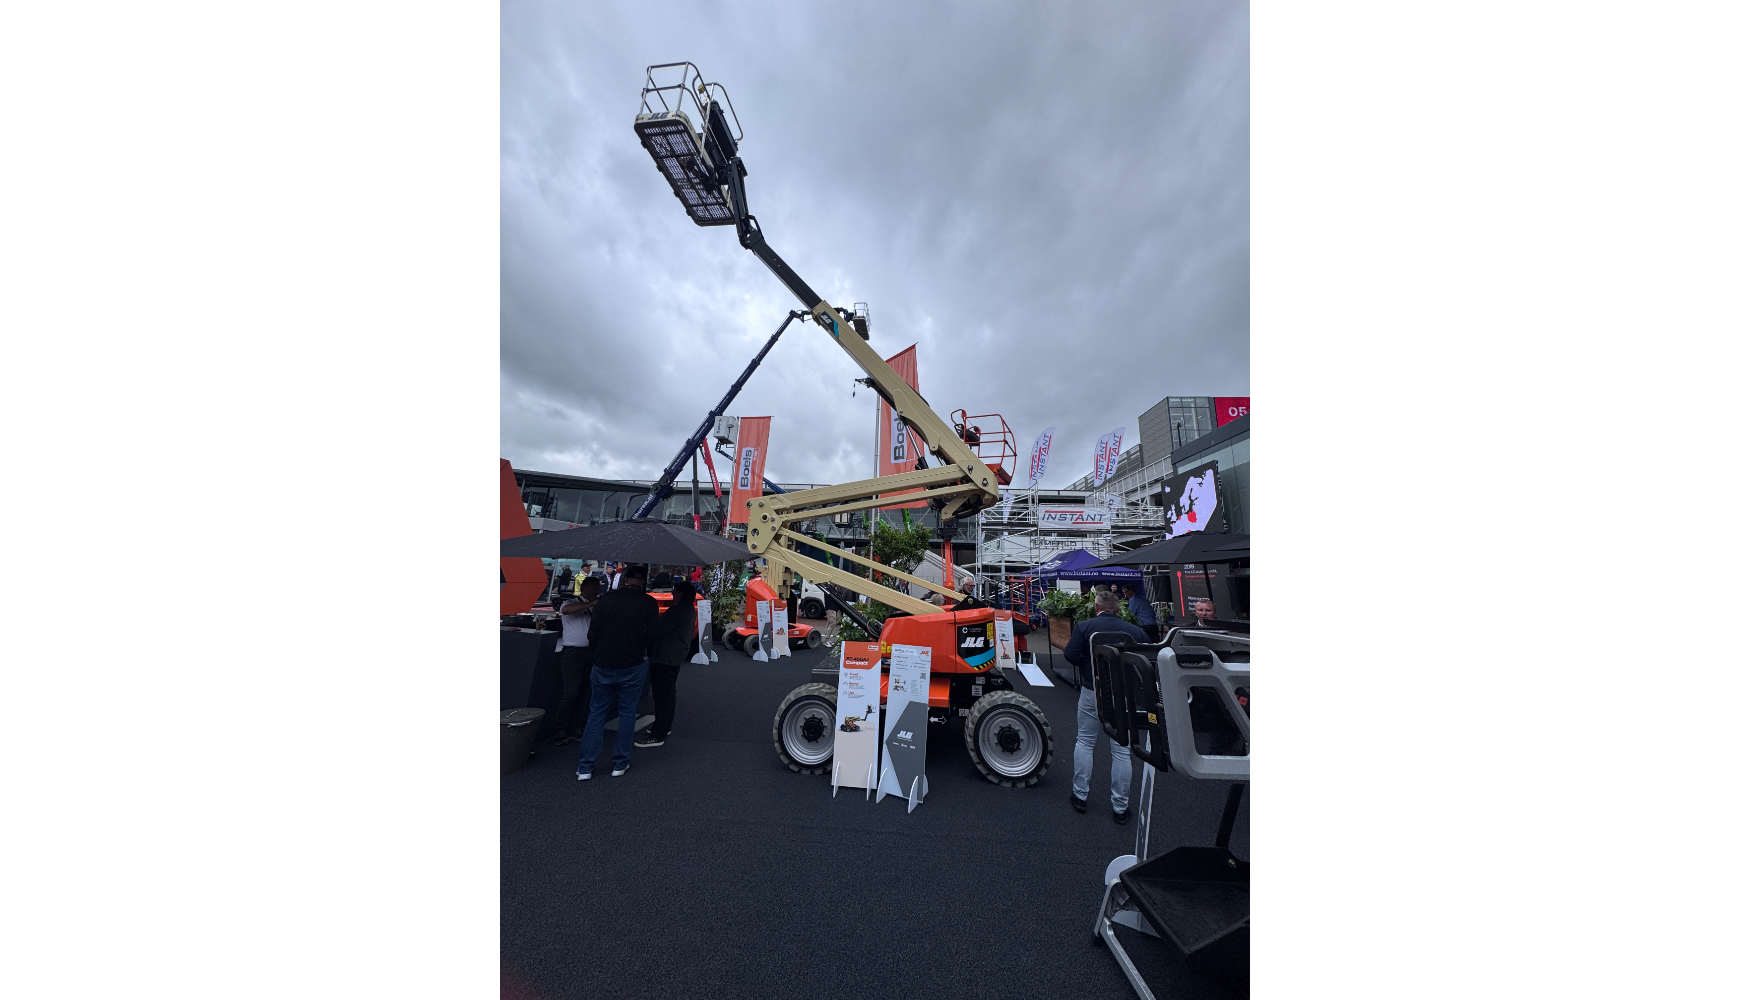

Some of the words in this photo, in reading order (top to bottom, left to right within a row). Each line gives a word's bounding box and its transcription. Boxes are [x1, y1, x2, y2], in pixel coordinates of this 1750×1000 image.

[648, 112, 670, 120] JLG
[740, 449, 752, 488] Boels
[1037, 432, 1050, 476] INSTANT
[1097, 440, 1106, 480] INSTANT
[1108, 432, 1120, 475] INSTANT
[1042, 513, 1106, 522] INSTANT
[961, 637, 985, 647] JLG
